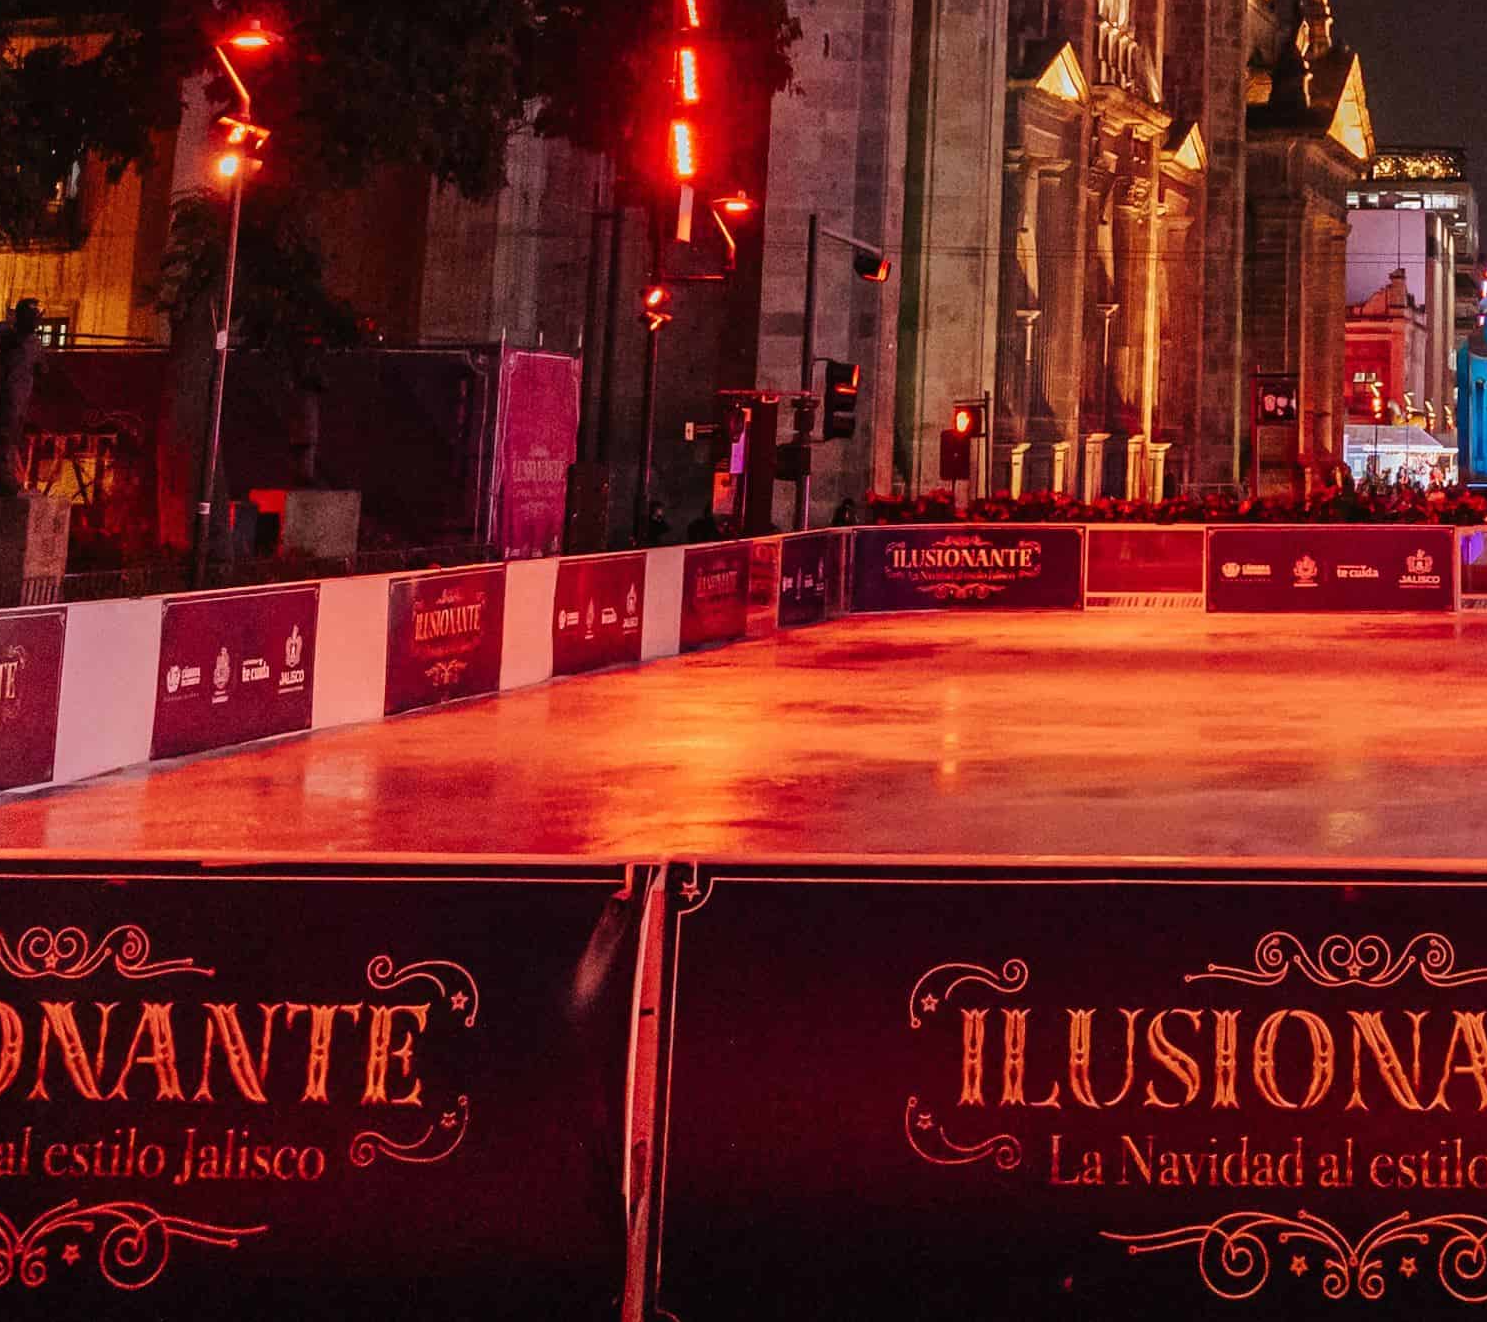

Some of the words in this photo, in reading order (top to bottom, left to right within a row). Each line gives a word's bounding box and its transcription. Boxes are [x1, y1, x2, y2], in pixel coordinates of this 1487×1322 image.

[893, 549, 1032, 568] ILUSIONANTE
[1337, 568, 1347, 578] te
[1349, 567, 1379, 578] cuida
[1399, 575, 1441, 584] JALISCO
[279, 669, 305, 686] JALISCO
[43, 1127, 165, 1177] estilo
[173, 1127, 325, 1185] Jalisco
[1049, 1135, 1106, 1186] La
[1117, 1135, 1305, 1187] Navidad
[1318, 1138, 1353, 1188] al
